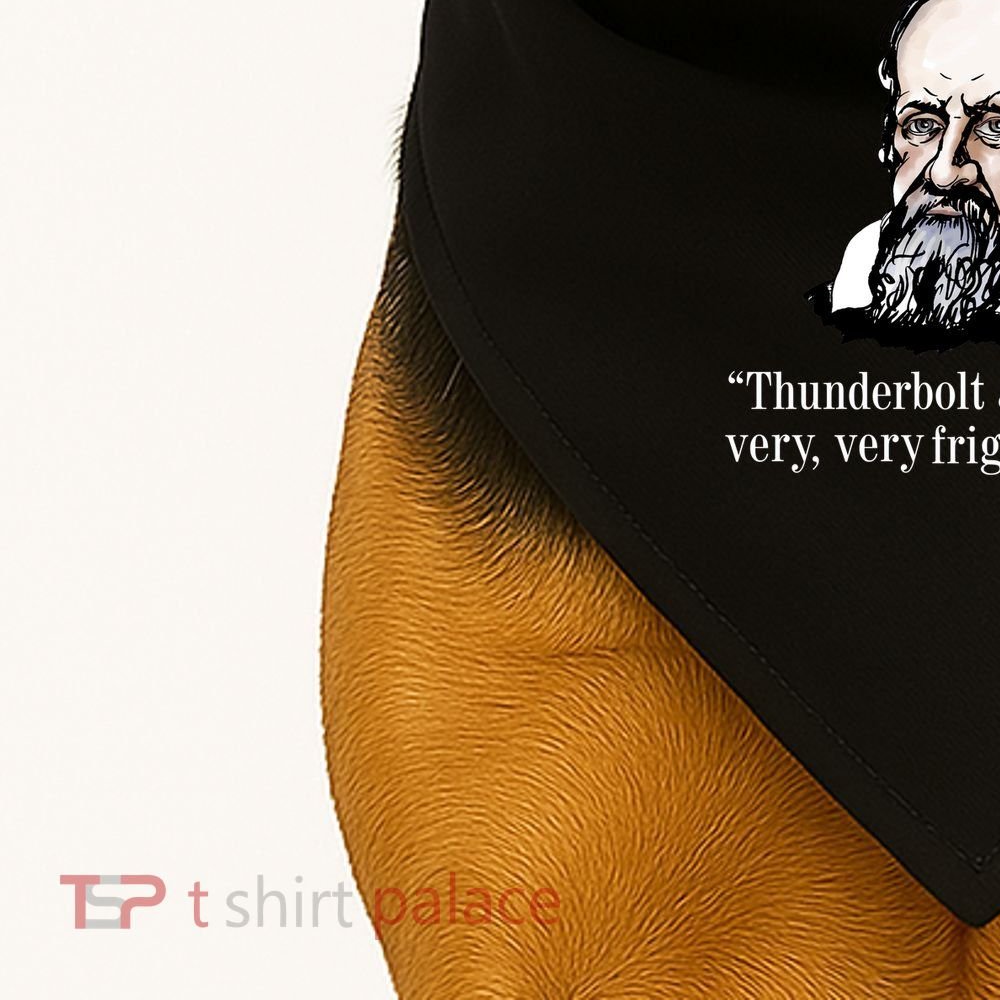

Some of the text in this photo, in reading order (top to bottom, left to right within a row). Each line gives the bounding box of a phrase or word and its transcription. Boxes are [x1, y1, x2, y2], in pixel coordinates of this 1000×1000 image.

[727, 370, 985, 411] “Thunderbolt
[725, 433, 820, 474] very,
[834, 433, 925, 474] very
